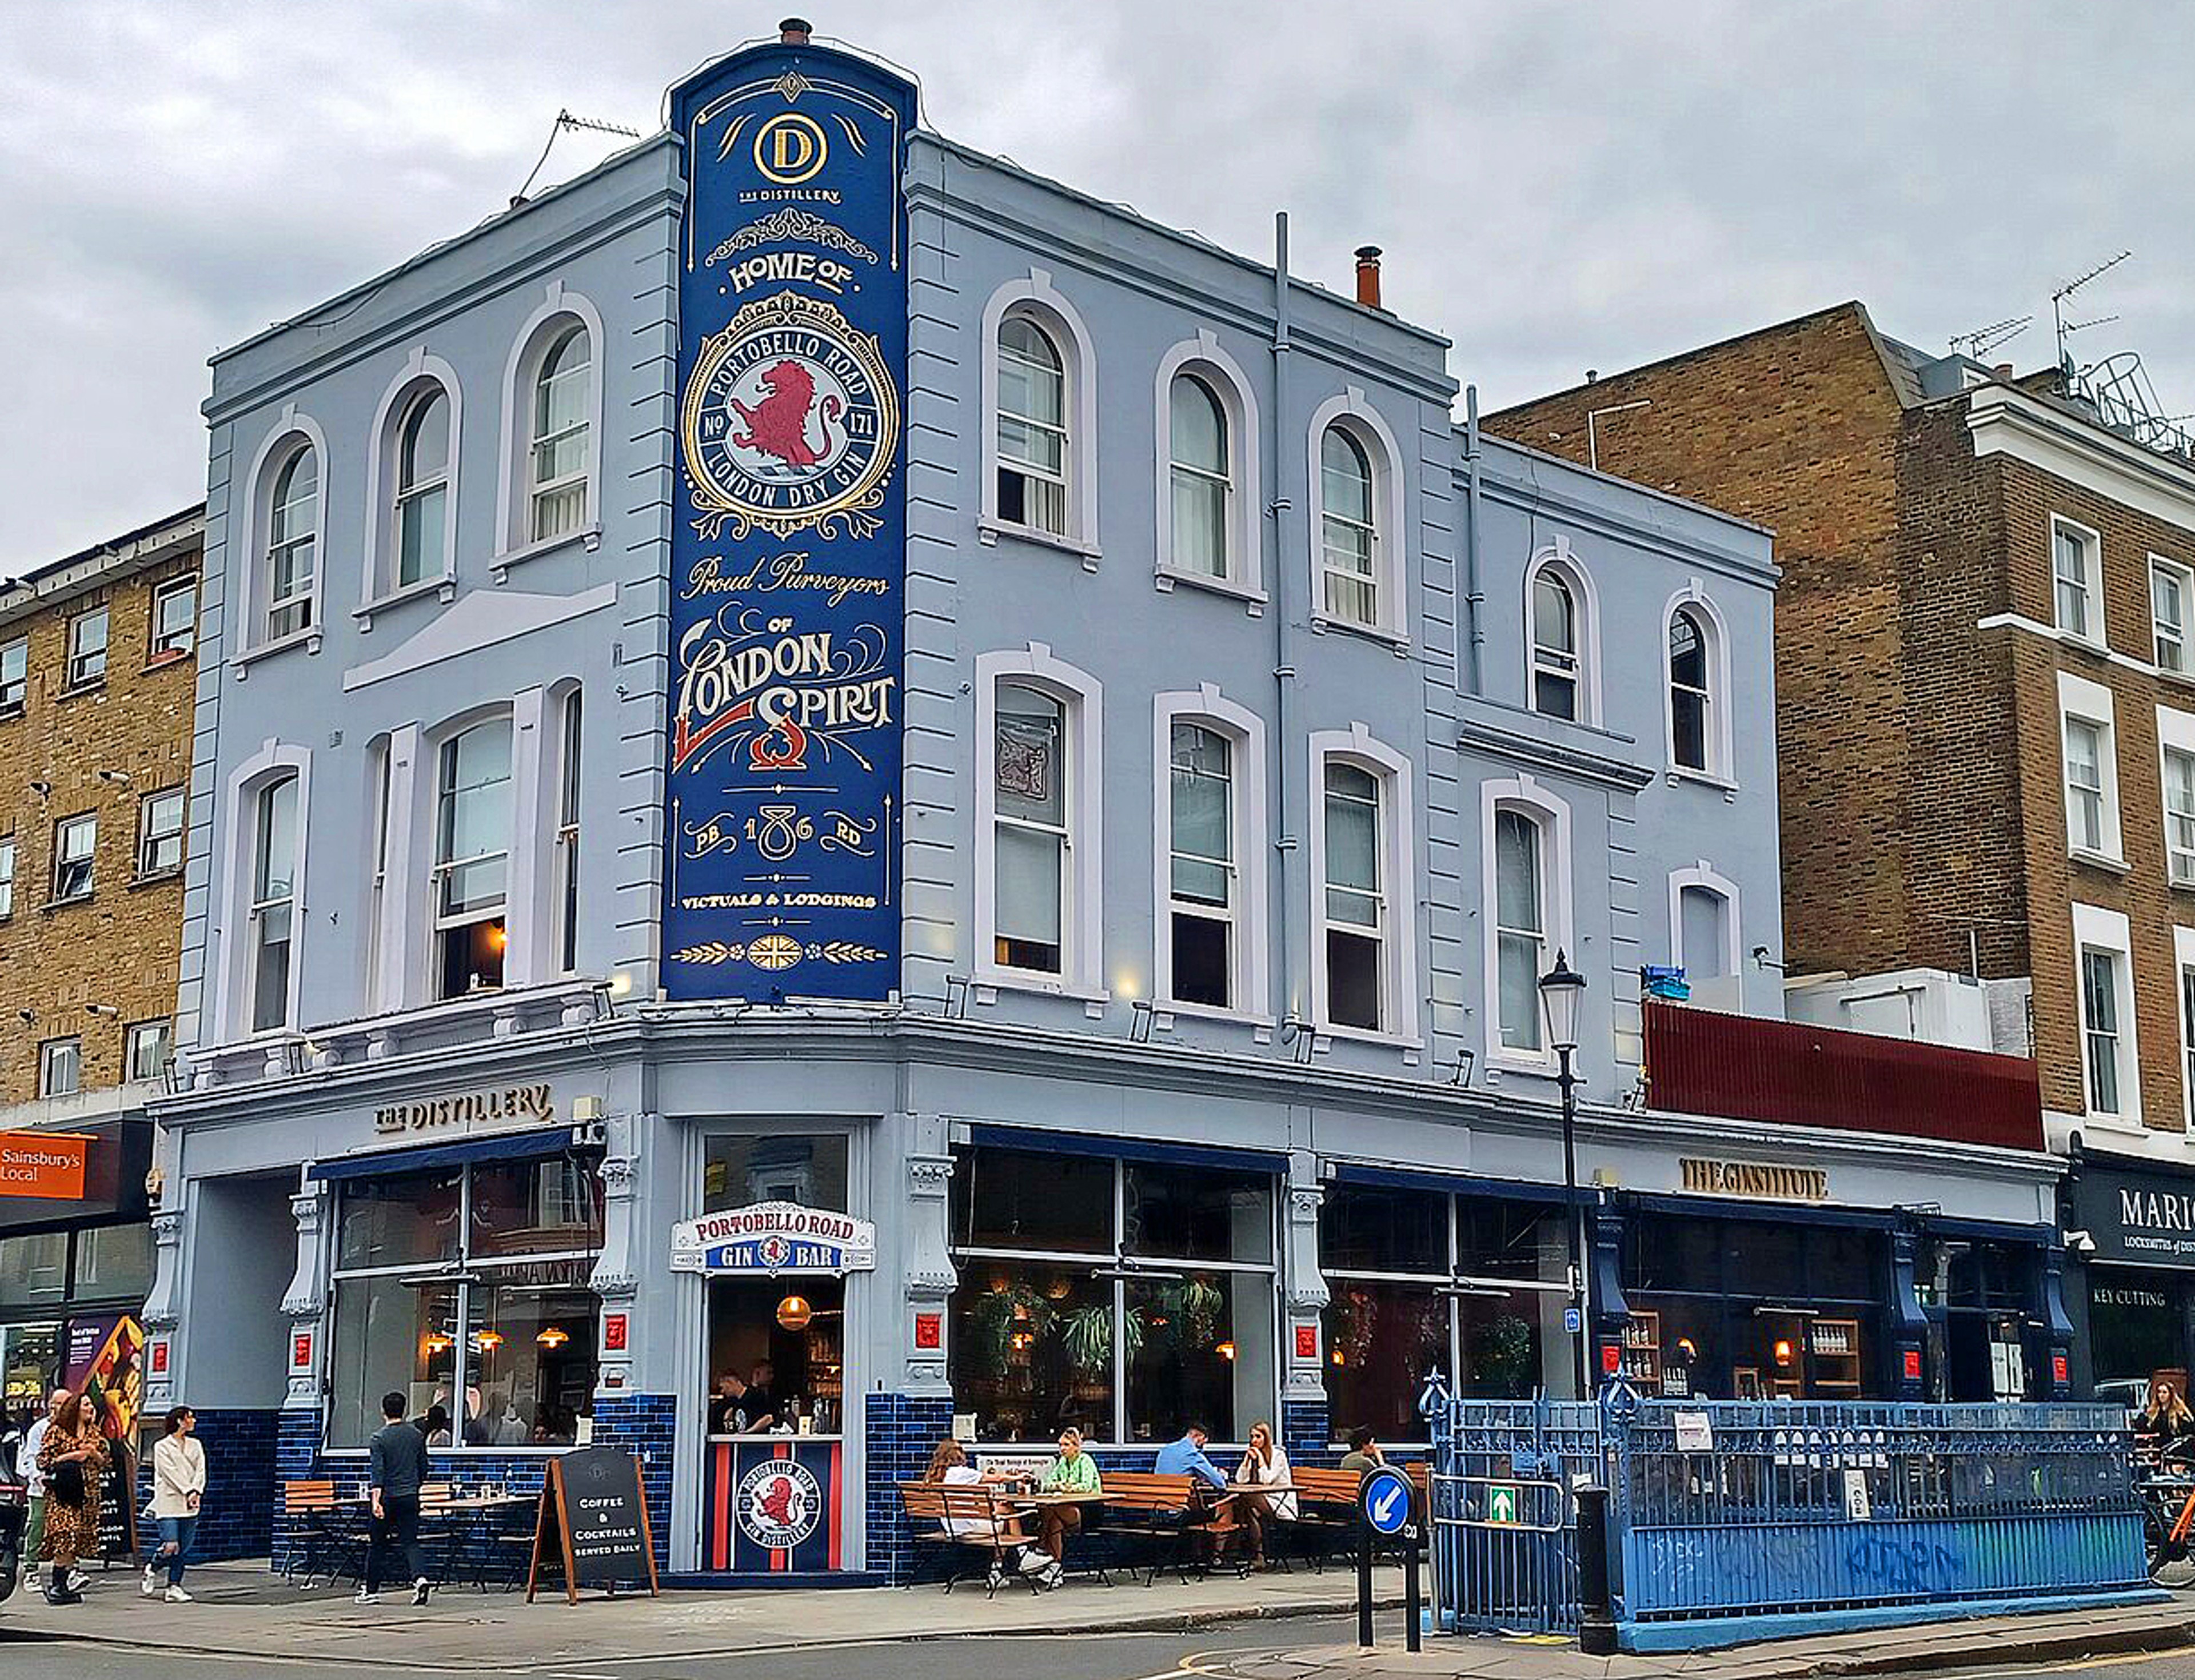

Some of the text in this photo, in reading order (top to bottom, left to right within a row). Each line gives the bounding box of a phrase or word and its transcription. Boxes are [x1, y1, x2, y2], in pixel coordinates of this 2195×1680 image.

[773, 129, 812, 168] D
[761, 190, 841, 204] DISTILLERY
[729, 253, 853, 293] HOME OF
[711, 333, 868, 396] PORTOBELLO ROAD
[849, 412, 873, 436] 171
[707, 451, 868, 507] LONDON DRY GIN
[680, 552, 889, 608] Proud Purveyors
[749, 676, 896, 771] SPIRIT
[695, 825, 720, 852] PB
[836, 822, 861, 845] RD
[682, 893, 877, 909] VICTUALS & LODGINGS
[412, 1084, 554, 1130] DISTILLERY
[1, 1148, 81, 1170] Sainsbury's
[1, 1166, 38, 1182] Local
[2119, 1188, 2195, 1231] MARI
[695, 1213, 854, 1241] PORTOBELLO ROAD
[721, 1246, 753, 1267] GIN
[796, 1246, 833, 1267] BAR
[2094, 1288, 2166, 1307] KEY CUTTING
[579, 1497, 624, 1509] COFFEE
[575, 1527, 637, 1541] COCKTAILS
[574, 1544, 640, 1557] SERVED DAILY
